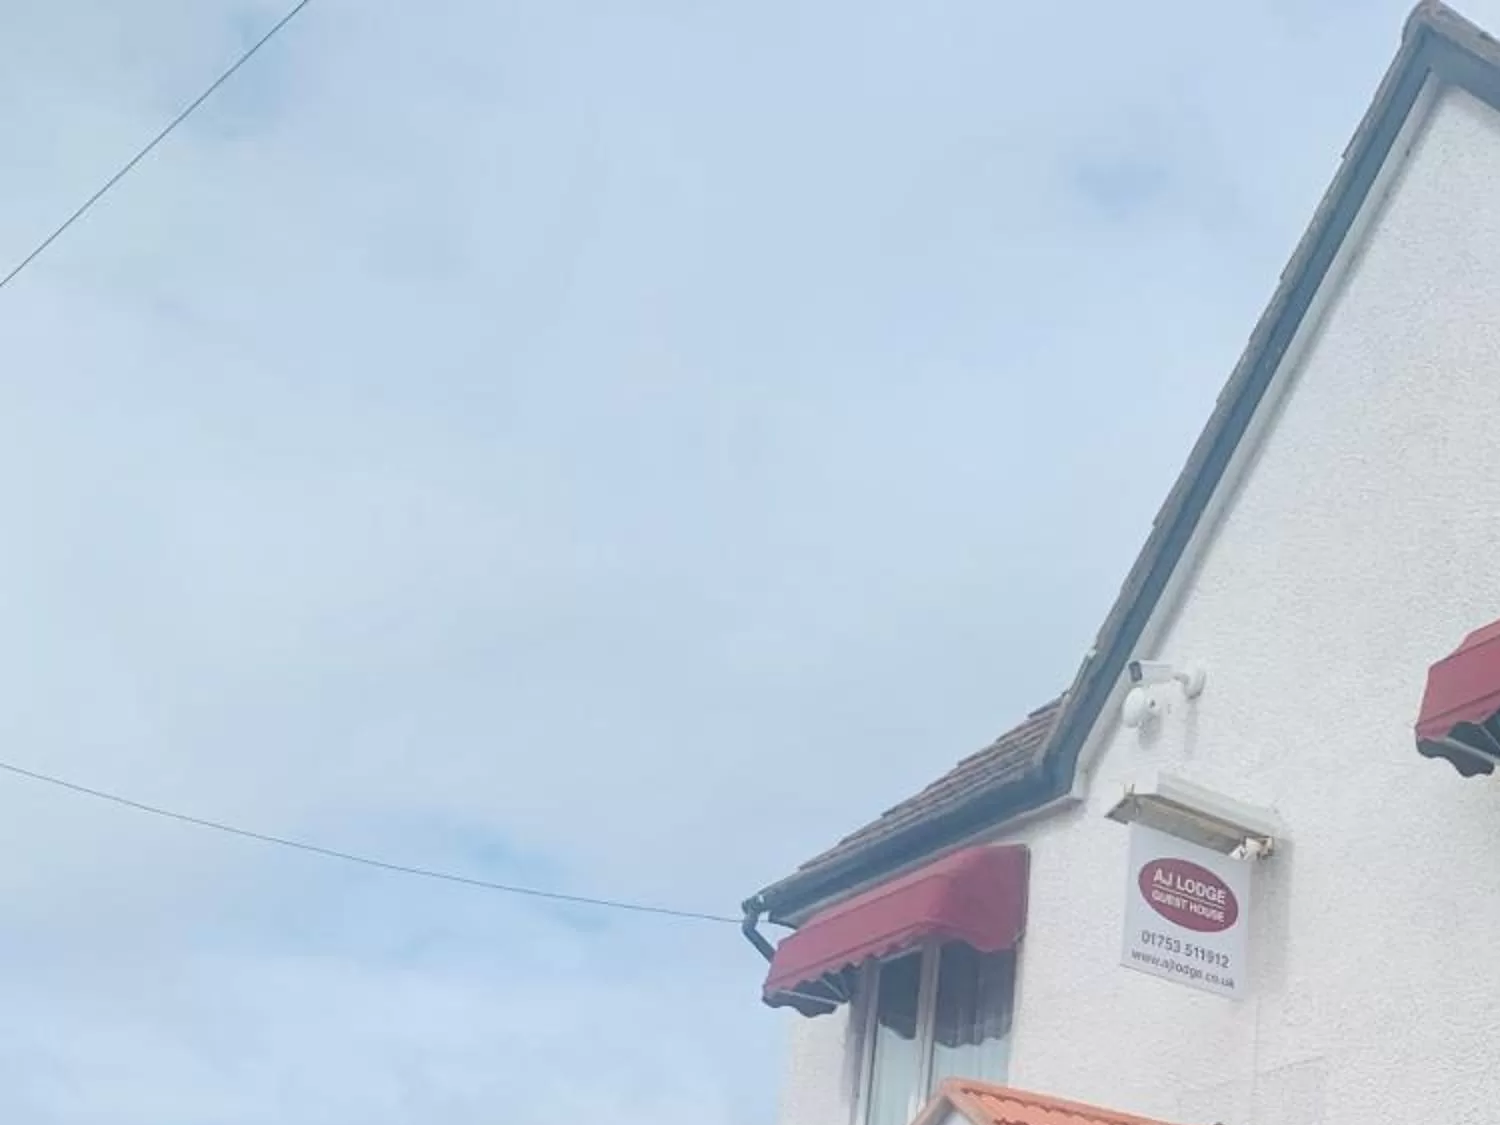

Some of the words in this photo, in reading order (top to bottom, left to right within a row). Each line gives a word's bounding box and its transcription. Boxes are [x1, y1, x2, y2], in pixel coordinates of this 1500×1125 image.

[1152, 867, 1173, 887] AJ
[1176, 874, 1225, 904] LODGE
[1151, 889, 1188, 910] GUEST
[1189, 900, 1225, 923] HOUSE
[1141, 929, 1181, 953] 01753
[1184, 943, 1230, 969] 511912
